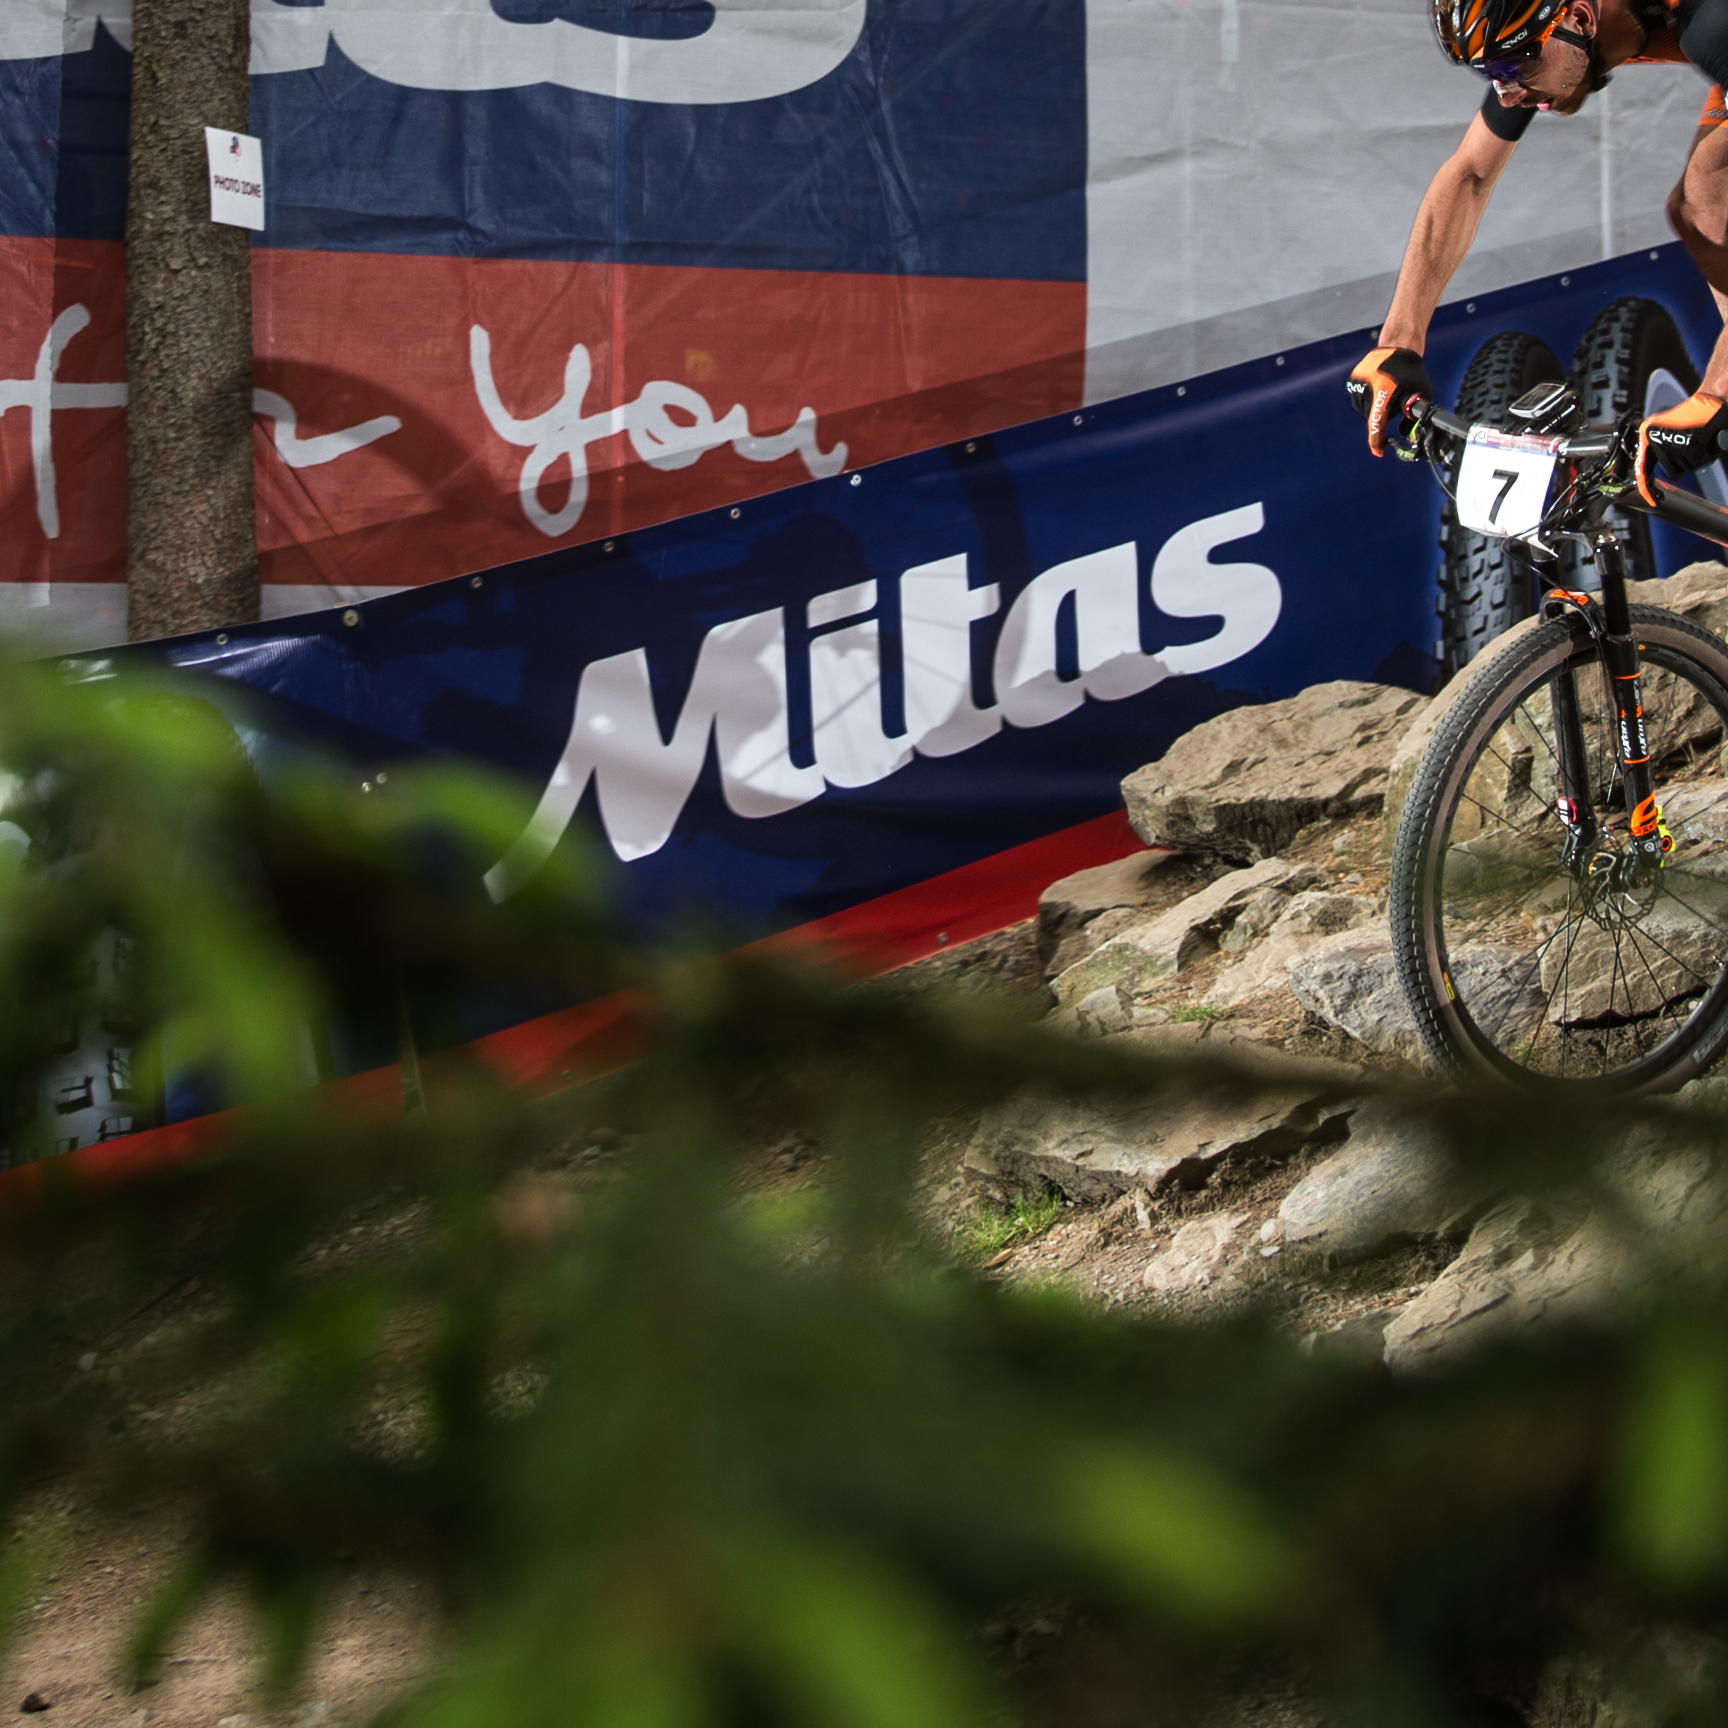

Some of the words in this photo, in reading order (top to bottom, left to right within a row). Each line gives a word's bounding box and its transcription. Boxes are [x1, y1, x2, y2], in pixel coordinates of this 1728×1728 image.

[214, 175, 240, 193] PHOTO
[241, 180, 262, 198] ZONE
[470, 324, 847, 537] You
[1370, 389, 1388, 435] VICTOR
[1488, 468, 1520, 525] 7
[484, 501, 1283, 906] Mitas
